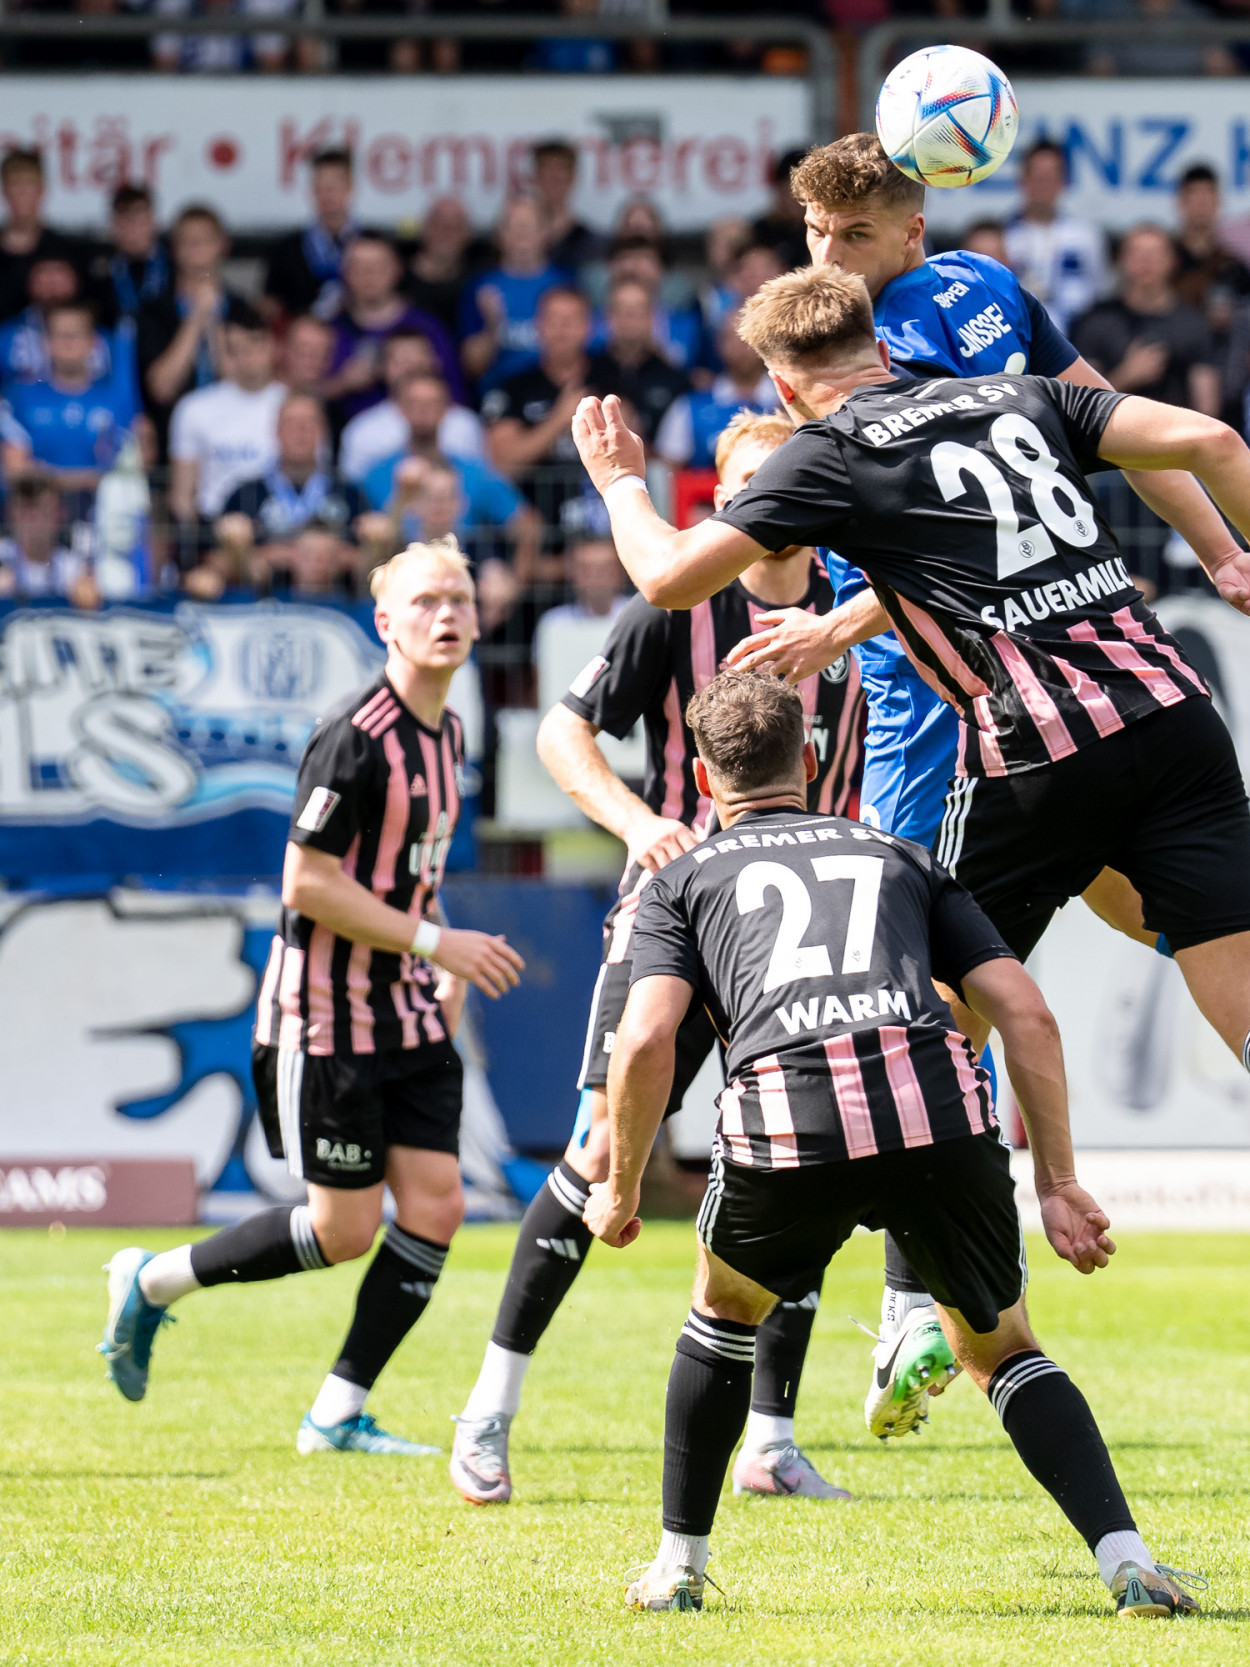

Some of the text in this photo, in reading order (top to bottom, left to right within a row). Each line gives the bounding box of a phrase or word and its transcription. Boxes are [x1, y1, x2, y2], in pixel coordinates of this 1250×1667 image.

[977, 382, 1019, 404] SV
[930, 412, 1099, 582] 28
[692, 827, 894, 864] BREMER SV
[735, 854, 885, 995] 27
[774, 988, 913, 1037] WARM
